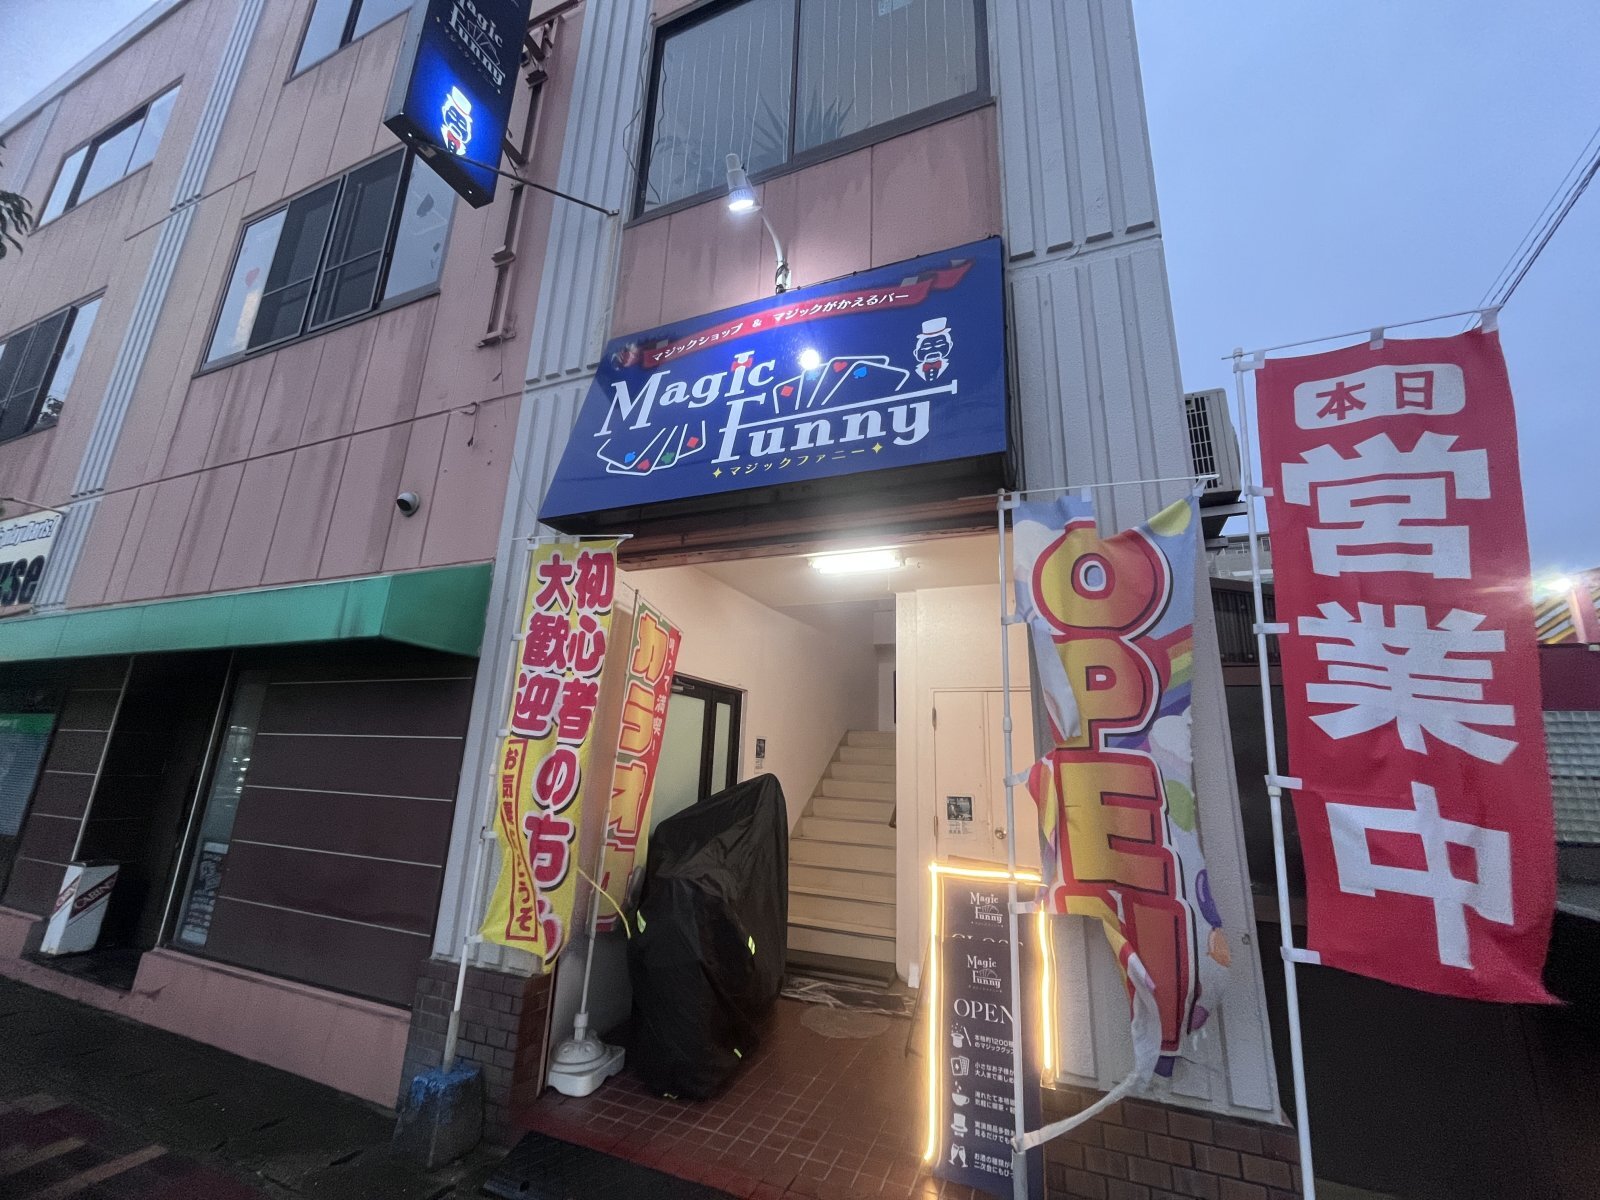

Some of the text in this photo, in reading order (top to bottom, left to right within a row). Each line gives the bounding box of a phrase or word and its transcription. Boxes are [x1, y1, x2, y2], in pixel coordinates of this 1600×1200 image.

[449, 3, 506, 86] Funny
[458, 0, 503, 48] agic
[652, 292, 909, 361] マジックショップ & マジックがかえるバー
[594, 349, 776, 437] Magic
[1315, 369, 1436, 422] 本日
[711, 390, 940, 465] Funny
[729, 449, 865, 476] マジックファニー
[511, 553, 573, 736] 大歓迎
[1281, 430, 1520, 970] 営業中
[970, 891, 999, 906] Magic
[975, 906, 1003, 924] Funny
[967, 954, 997, 970] Magic
[972, 970, 1002, 989] Funny
[953, 998, 1013, 1025] OPEN
